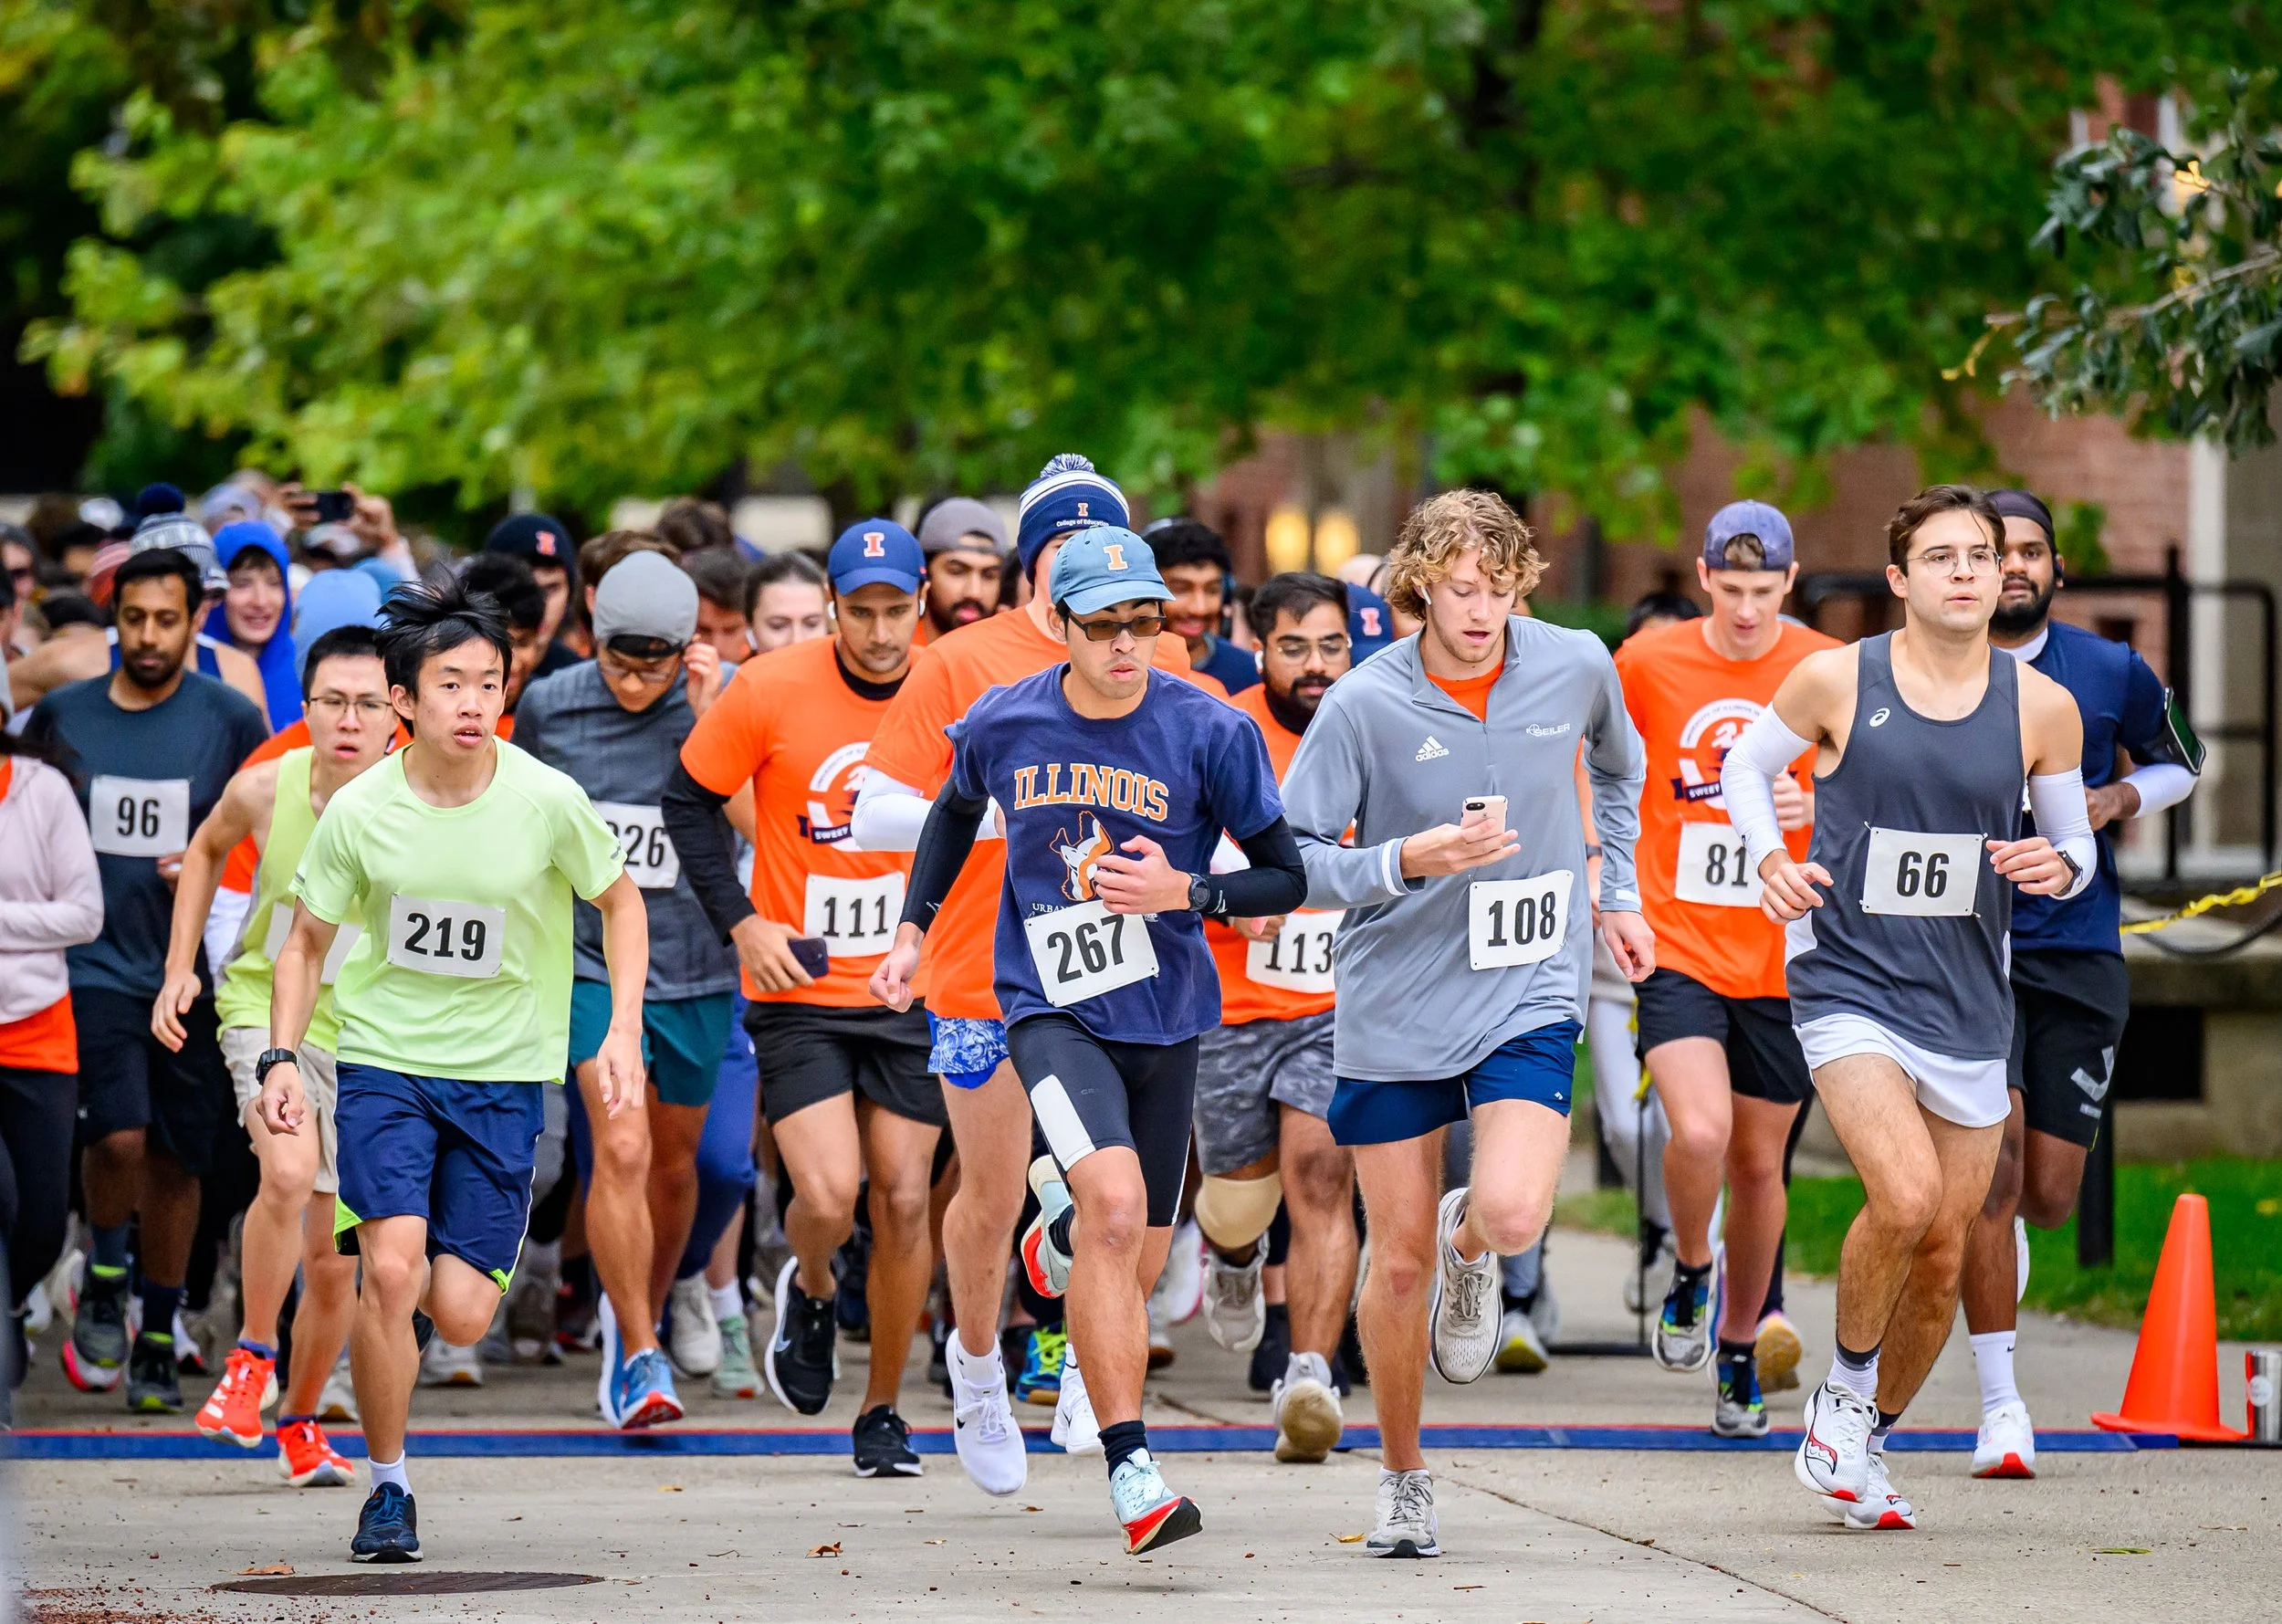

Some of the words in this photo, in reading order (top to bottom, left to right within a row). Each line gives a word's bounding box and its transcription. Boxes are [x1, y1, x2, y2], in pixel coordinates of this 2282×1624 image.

[1078, 502, 1089, 517] I
[863, 531, 885, 558] I
[1103, 544, 1129, 571] I
[1360, 607, 1382, 636] I
[1534, 723, 1570, 737] SEILER
[1415, 748, 1450, 762] adidas
[1014, 762, 1169, 822] ILLINOIS
[117, 796, 160, 838] 96
[1704, 843, 1749, 888] 81
[1896, 851, 1950, 898] 66
[404, 912, 487, 962] 219
[822, 895, 889, 938] 111
[1487, 891, 1556, 948] 108
[1046, 913, 1125, 984] 267
[1264, 931, 1335, 974] 113
